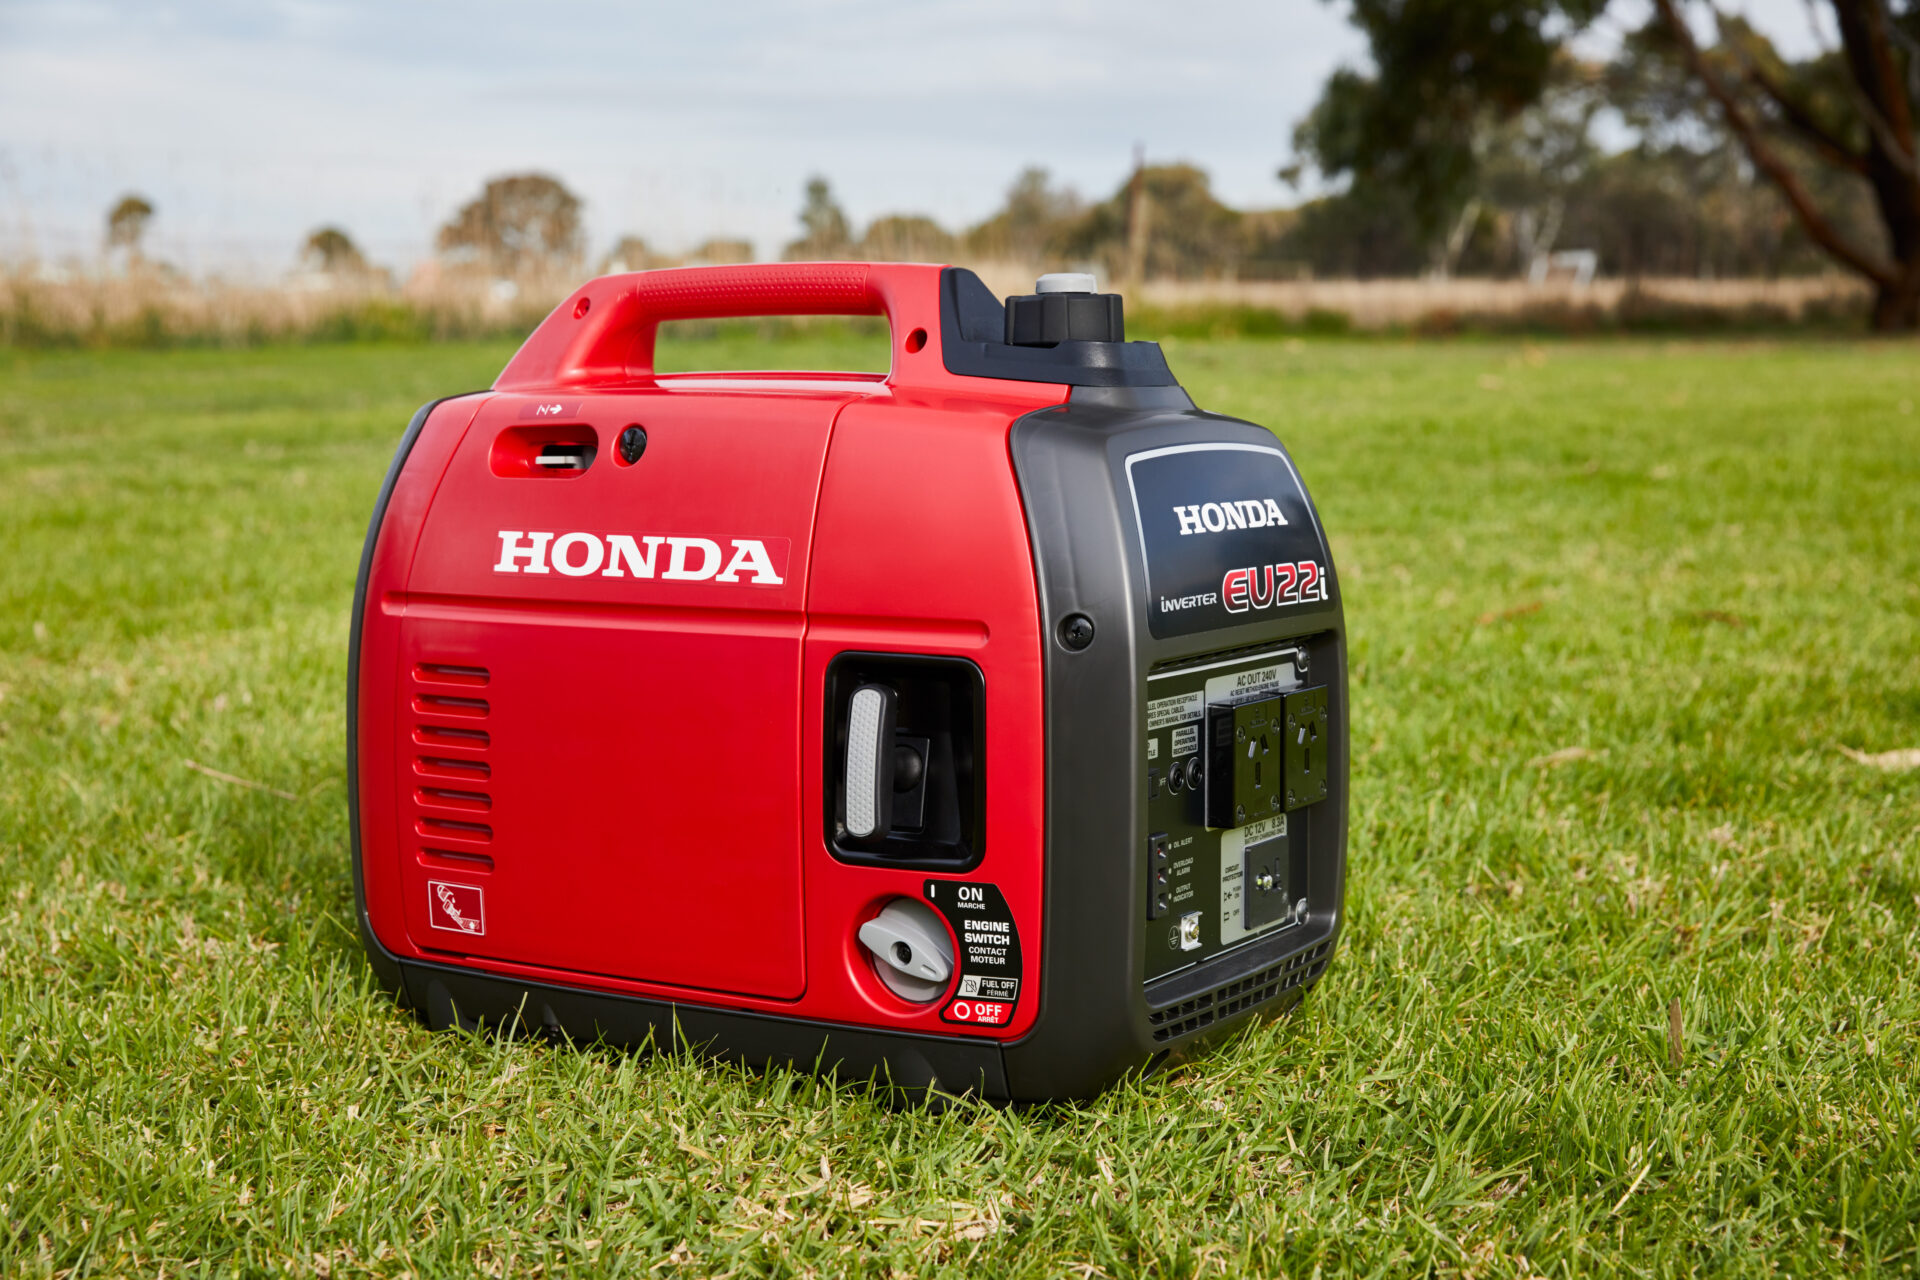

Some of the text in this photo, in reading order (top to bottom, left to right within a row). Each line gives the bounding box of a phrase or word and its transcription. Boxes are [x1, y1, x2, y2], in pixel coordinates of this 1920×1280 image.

[1173, 499, 1288, 536] HONDA
[494, 531, 784, 585] HONDA
[1222, 560, 1329, 614] EU22i
[1237, 669, 1277, 687] AC OUT 240V
[1157, 699, 1176, 708] OPERATION
[1157, 709, 1170, 718] SPECIAL
[1171, 706, 1184, 714] CABLES
[1188, 711, 1201, 719] DETAILS
[1175, 728, 1194, 737] PARALLEL
[1174, 736, 1196, 746] OPERATION
[1173, 744, 1197, 755] RECEPTACLE
[1244, 816, 1285, 838] DC 12V 8.3A
[1180, 836, 1192, 845] ALERT
[1173, 857, 1193, 869] OVERLOAD
[958, 886, 983, 901] ON
[957, 902, 986, 910] MARCHE
[964, 920, 1010, 933] ENGINE
[964, 933, 1010, 945] SWITCH
[968, 946, 1007, 956] CONTACT
[970, 955, 1006, 965] MOTEUR
[982, 980, 1015, 990] FUEL OFF
[975, 1003, 1002, 1017] OFF
